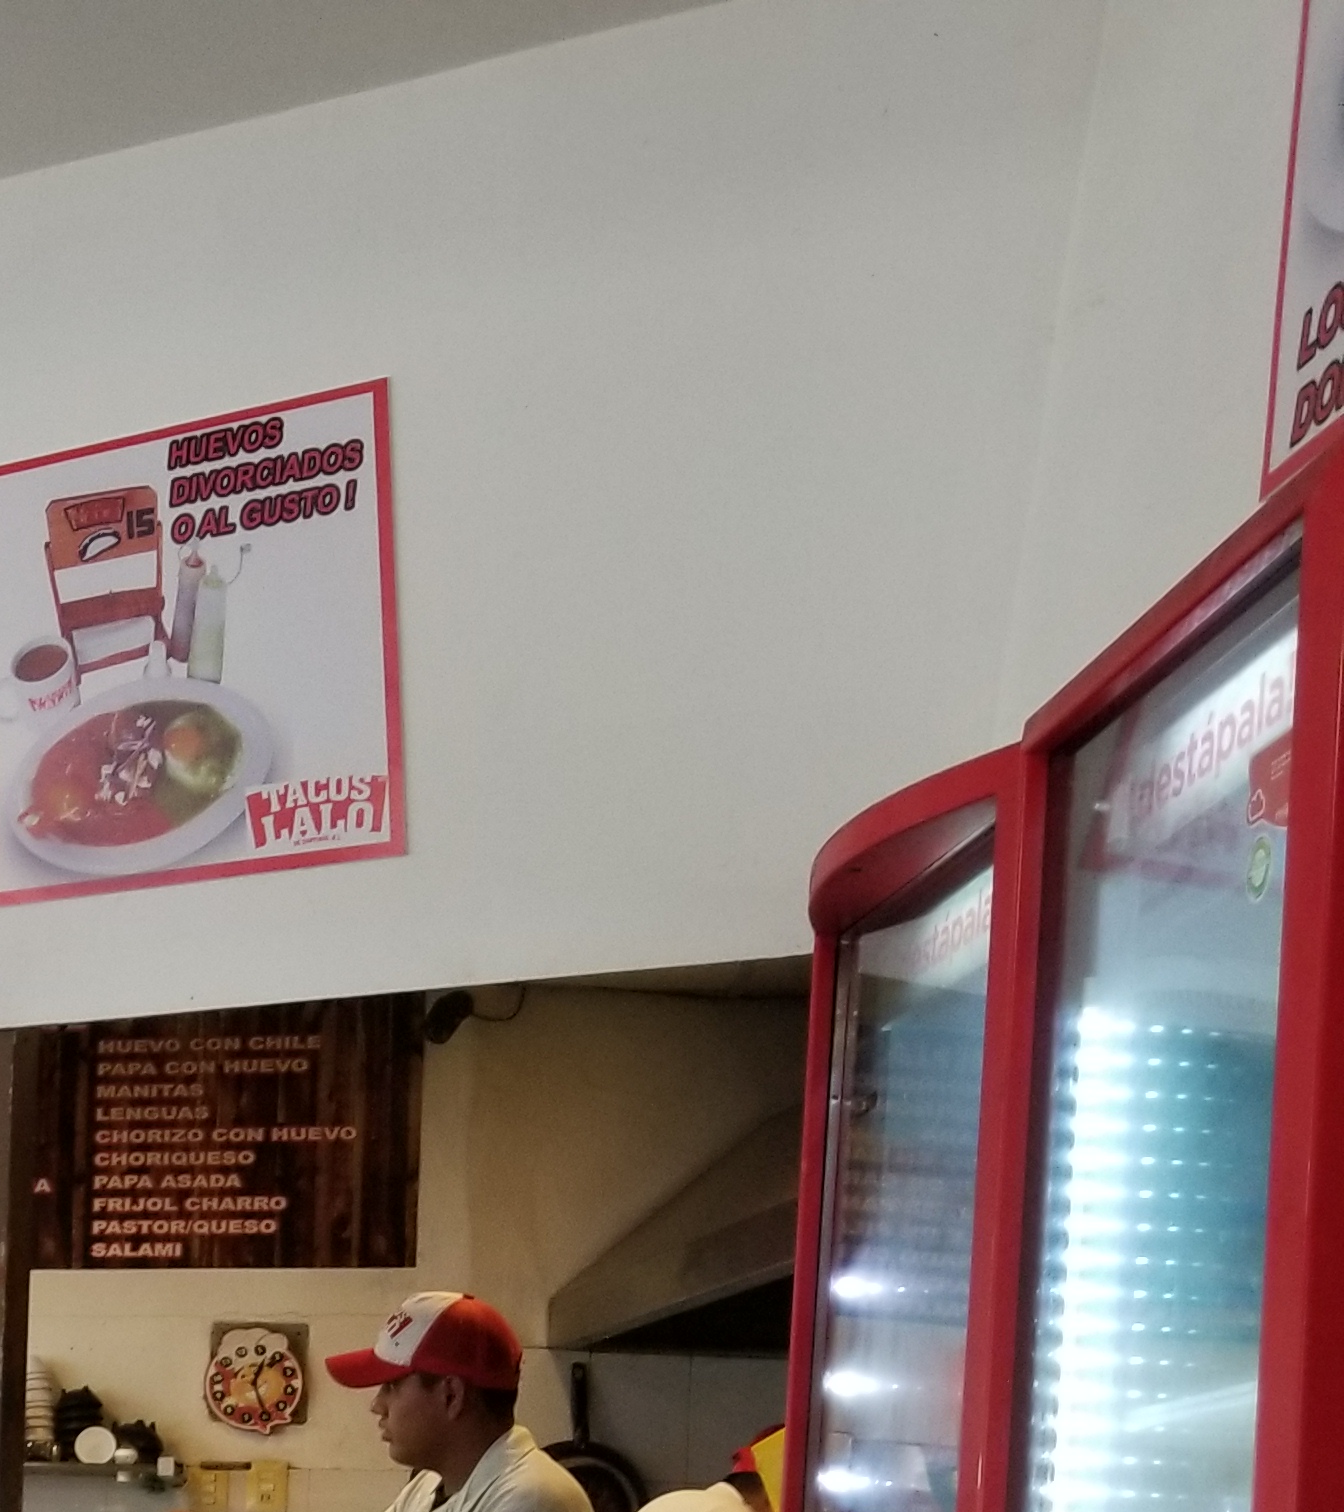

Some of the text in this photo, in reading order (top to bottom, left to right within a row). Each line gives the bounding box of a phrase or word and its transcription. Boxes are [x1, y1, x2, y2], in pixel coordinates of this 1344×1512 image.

[1297, 281, 1344, 371] LO
[168, 417, 284, 470] HUEVOS
[169, 439, 364, 508] DIVORCIADOS
[171, 513, 195, 544] O
[196, 505, 236, 540] AL
[240, 484, 340, 530] GUSTO
[261, 775, 371, 812] TACOS
[261, 801, 373, 843] LALO
[97, 1036, 322, 1053] HUEVO CON CHILE
[97, 1058, 309, 1076] PAPA CON HUEVO
[96, 1083, 204, 1098] MANITAS
[96, 1106, 209, 1121] LENGUAS
[95, 1126, 357, 1144] CHORIZO CON HUEVO
[93, 1150, 256, 1168] CHORIQUESO
[93, 1173, 242, 1190] PAPA ASADA
[91, 1196, 287, 1213] FRIJOL CHARRO
[90, 1219, 277, 1237] PASTOR/QUESO
[90, 1242, 182, 1258] SALAMI
